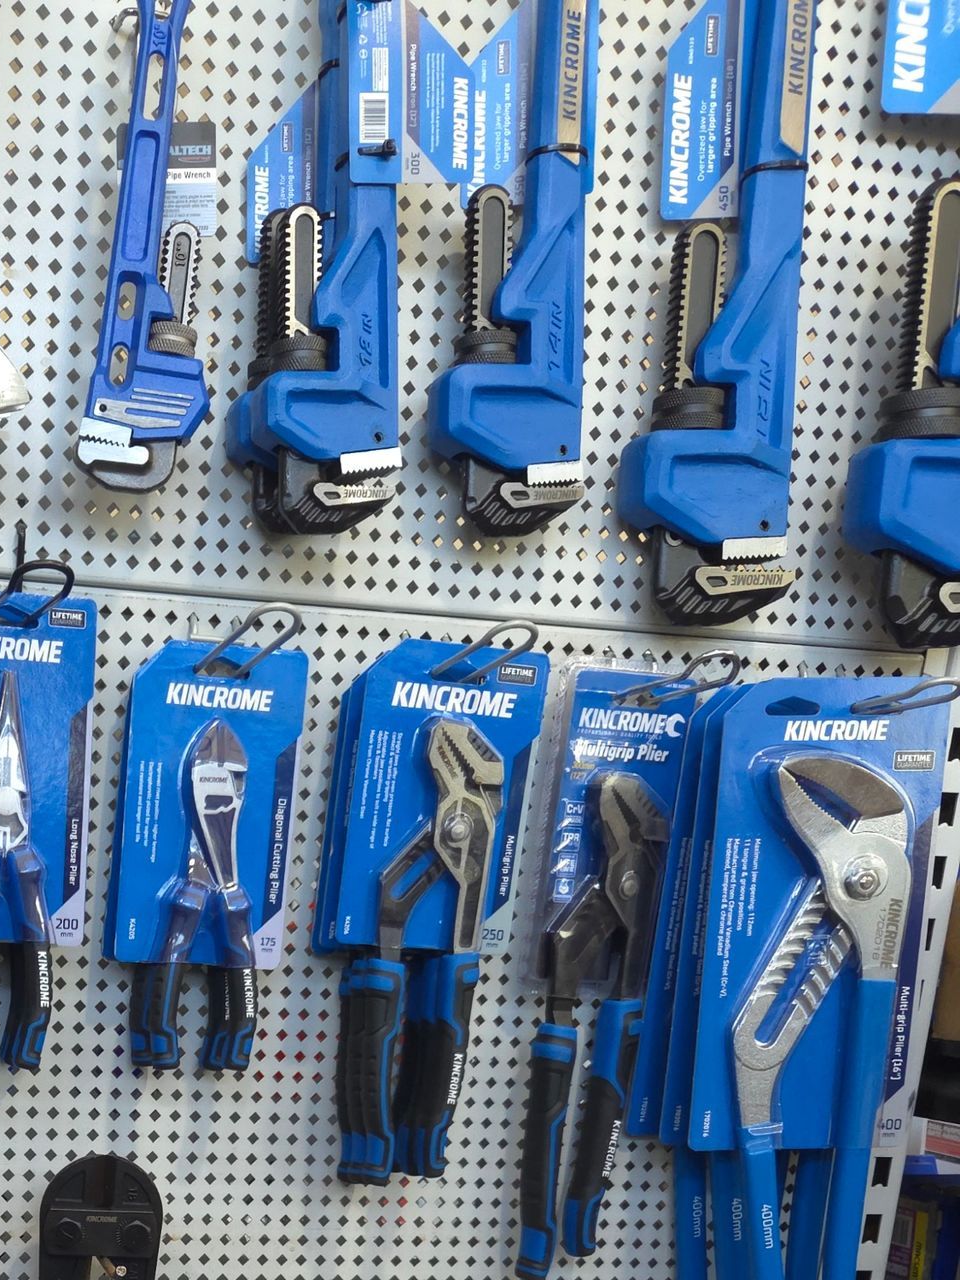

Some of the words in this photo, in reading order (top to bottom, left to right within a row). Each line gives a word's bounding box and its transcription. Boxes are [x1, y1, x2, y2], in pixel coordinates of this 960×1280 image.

[707, 17, 715, 54] LIFETIME
[563, 9, 581, 121] KINCROME
[709, 77, 717, 99] area
[453, 77, 468, 170] KINCROME
[698, 116, 708, 133] jaw
[707, 100, 717, 140] gripping
[668, 72, 692, 205] KINCROME
[410, 152, 420, 176] 300
[697, 134, 707, 182] Oversized
[706, 142, 714, 173] larger
[167, 172, 181, 186] Pipe
[184, 171, 211, 180] Wrench
[719, 184, 729, 212] 450
[730, 573, 783, 586] KINCROME
[51, 611, 83, 622] LIFETIME
[501, 666, 534, 677] LIFETIME
[166, 682, 273, 712] KINCROME
[392, 681, 518, 719] KINCROME
[579, 707, 668, 735] KINCROME
[784, 720, 890, 741] KINCROME
[573, 738, 636, 762] Multigrip
[637, 743, 670, 763] Plier
[273, 798, 286, 840] Diagonal
[567, 803, 585, 815] CrV
[69, 818, 79, 840] Long
[68, 841, 78, 864] Nose
[269, 843, 282, 880] Cutting
[501, 835, 515, 874] Multigrip
[68, 865, 78, 886] Plier
[499, 876, 509, 897] Plier
[268, 881, 279, 905] Plier
[55, 918, 79, 930] 200
[482, 928, 504, 941] 250
[879, 898, 903, 969] KINCROME
[260, 937, 276, 947] 175
[37, 951, 50, 1008] KINCROME
[242, 969, 255, 1019] KINCROME
[447, 1053, 464, 1106] KINCROME
[602, 1120, 622, 1178] KINCROME
[691, 1195, 702, 1239] 400mm
[761, 1203, 774, 1249] 400mm
